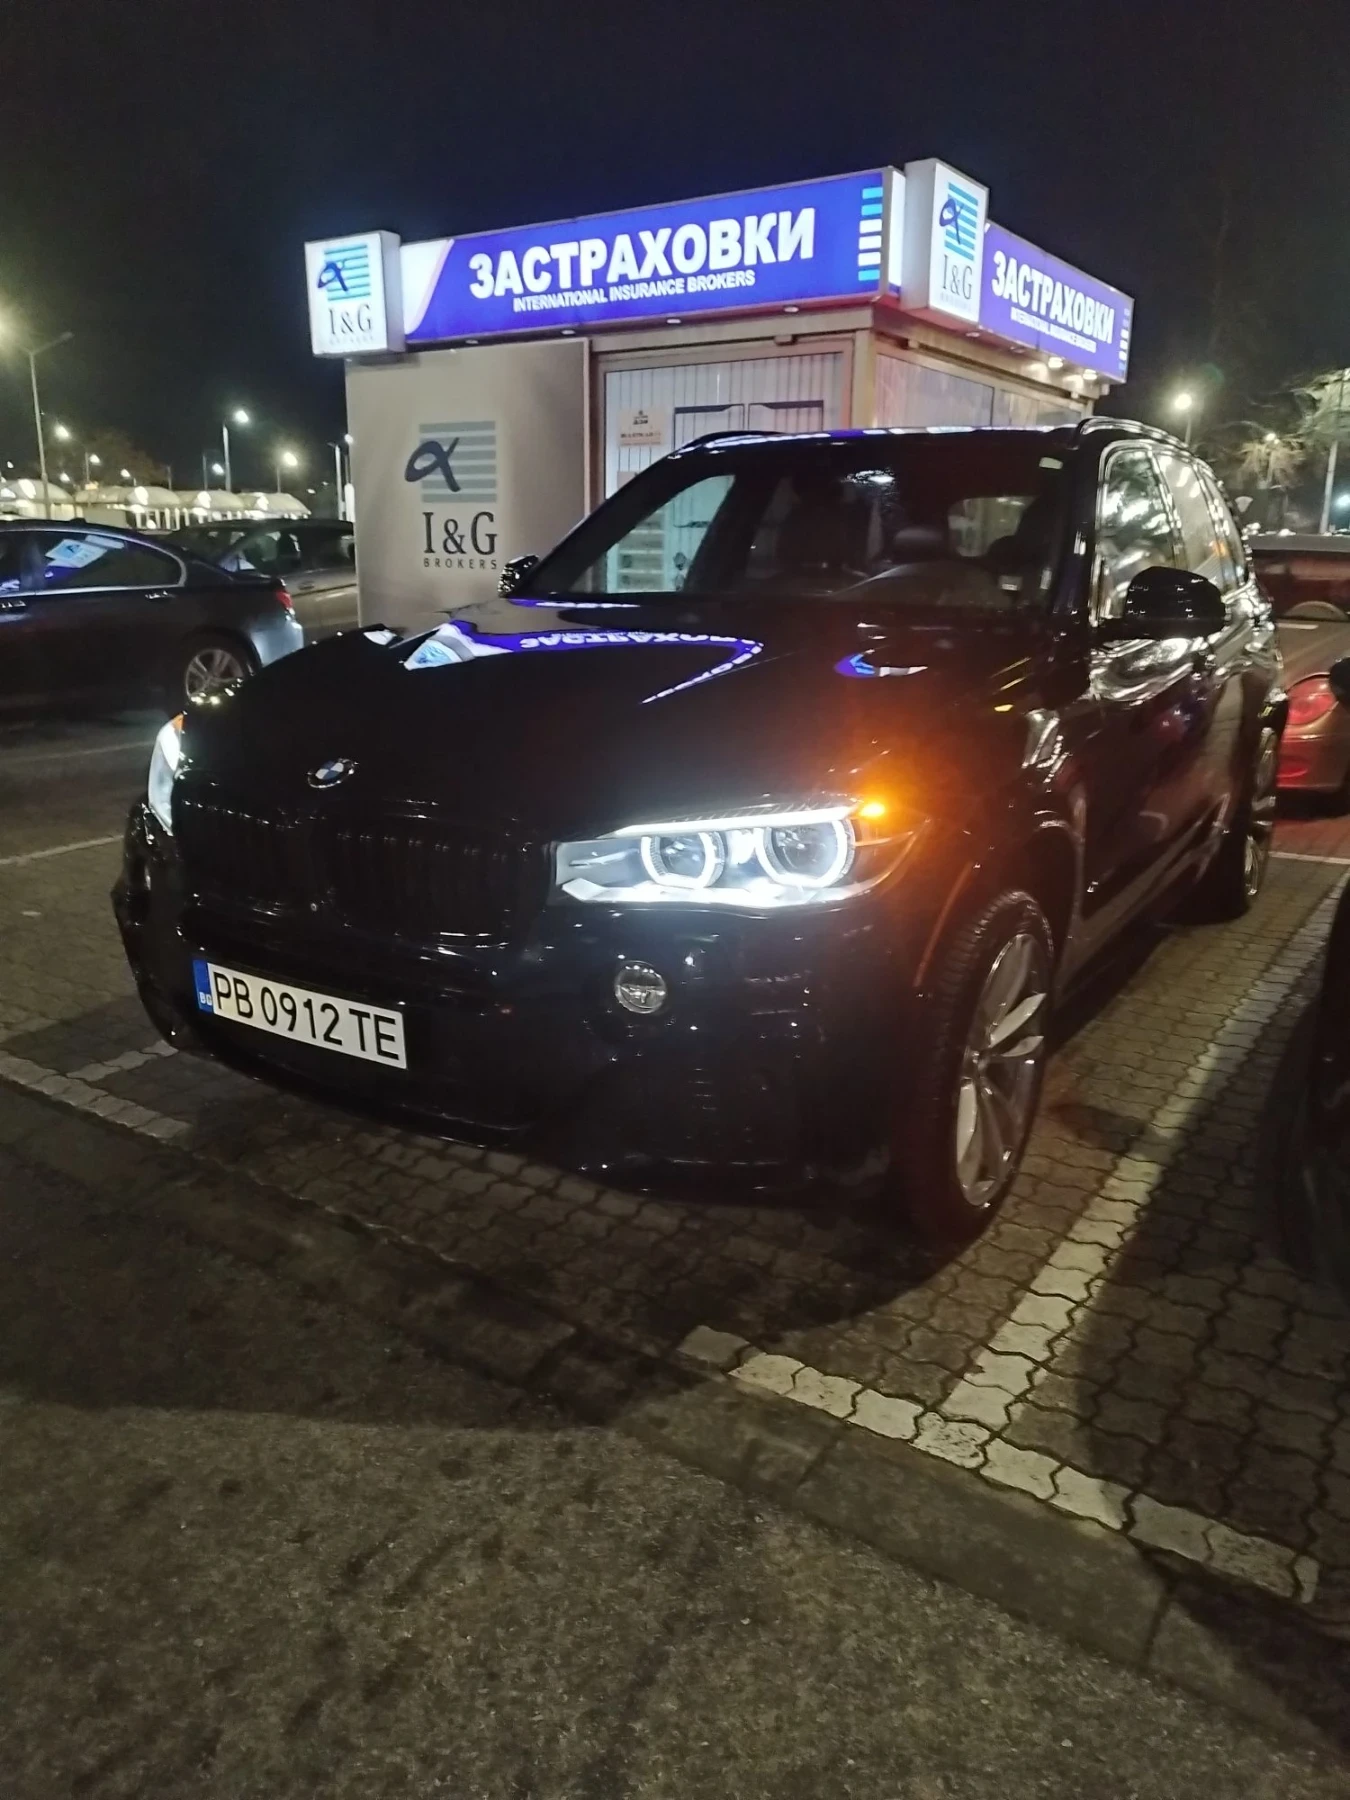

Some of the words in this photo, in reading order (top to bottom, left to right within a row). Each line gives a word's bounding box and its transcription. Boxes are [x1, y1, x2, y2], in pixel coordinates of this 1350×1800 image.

[468, 207, 815, 299] ЗАСТРАХОВКИ
[513, 288, 608, 313] INTERNATIONAL
[609, 277, 685, 302] INSURANCE
[687, 269, 756, 293] BROKERS
[942, 254, 973, 300] I&G
[991, 250, 1115, 344] ЗАСТРАХОВКИ
[328, 303, 372, 335] I&G
[422, 511, 498, 555] I&G
[423, 557, 497, 570] BROKERS
